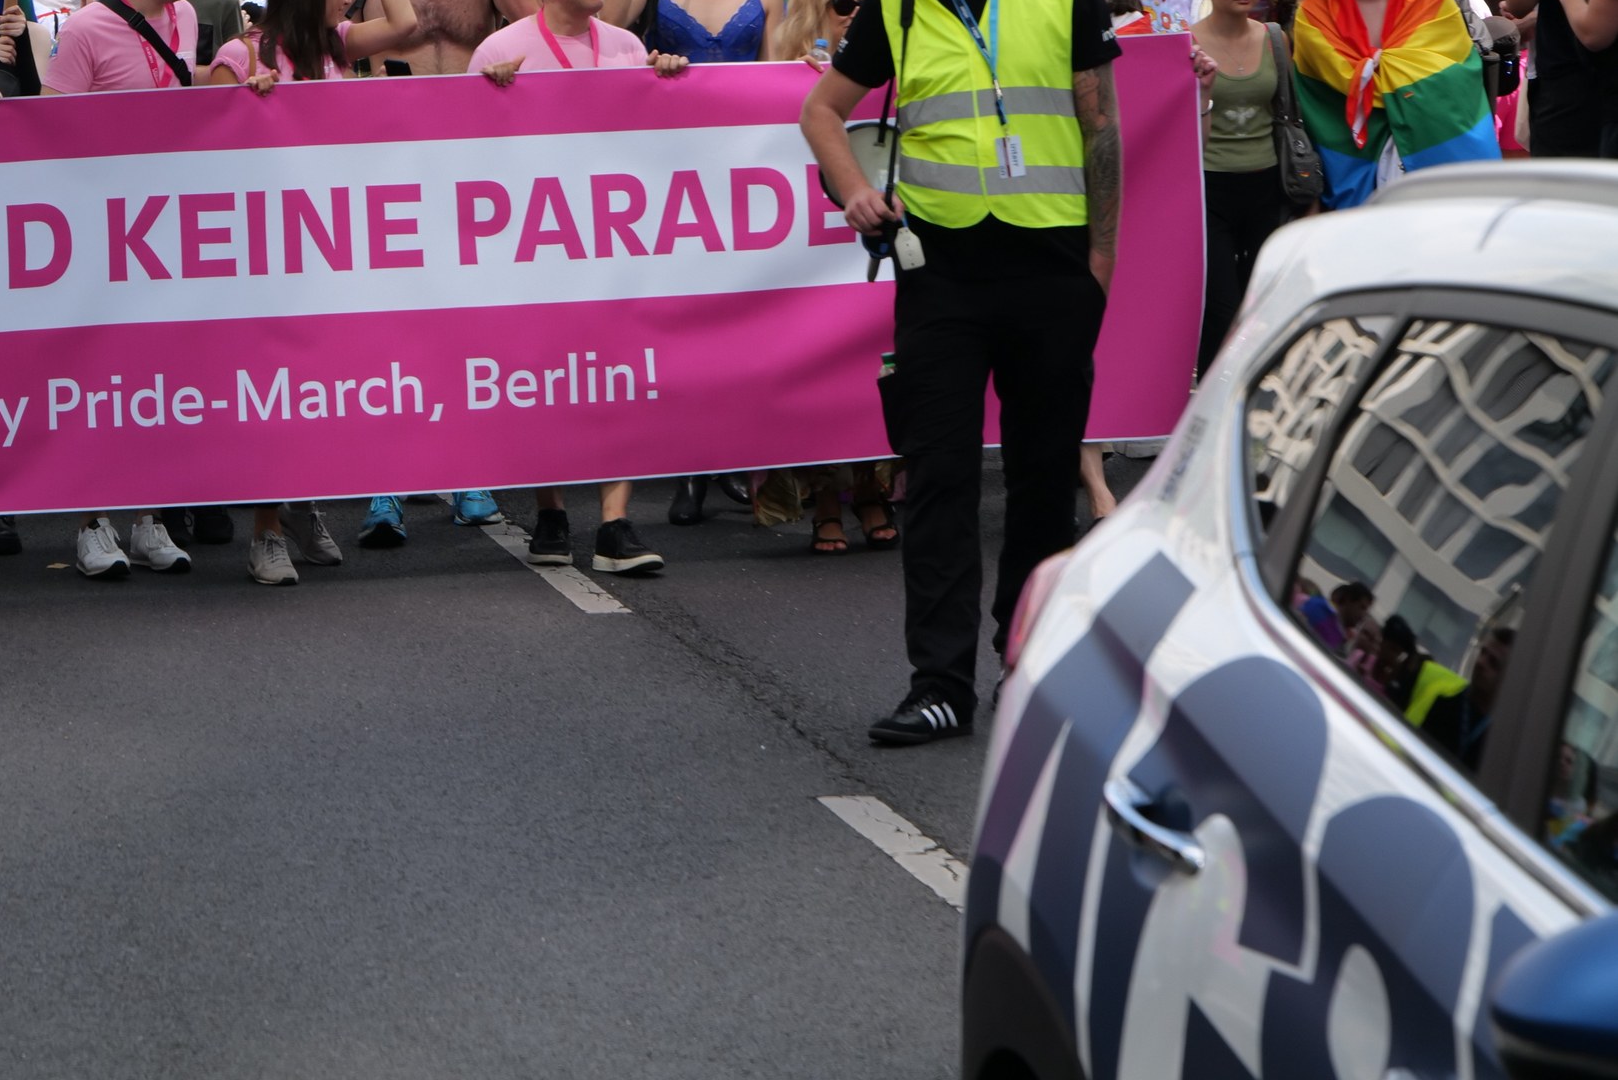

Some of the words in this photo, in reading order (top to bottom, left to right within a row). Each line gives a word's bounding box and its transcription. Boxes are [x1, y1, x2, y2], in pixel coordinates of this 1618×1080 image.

[107, 183, 425, 282] KEINE
[455, 163, 858, 266] PARADE
[48, 361, 445, 433] Pride-March,
[465, 348, 658, 411] Berlin!
